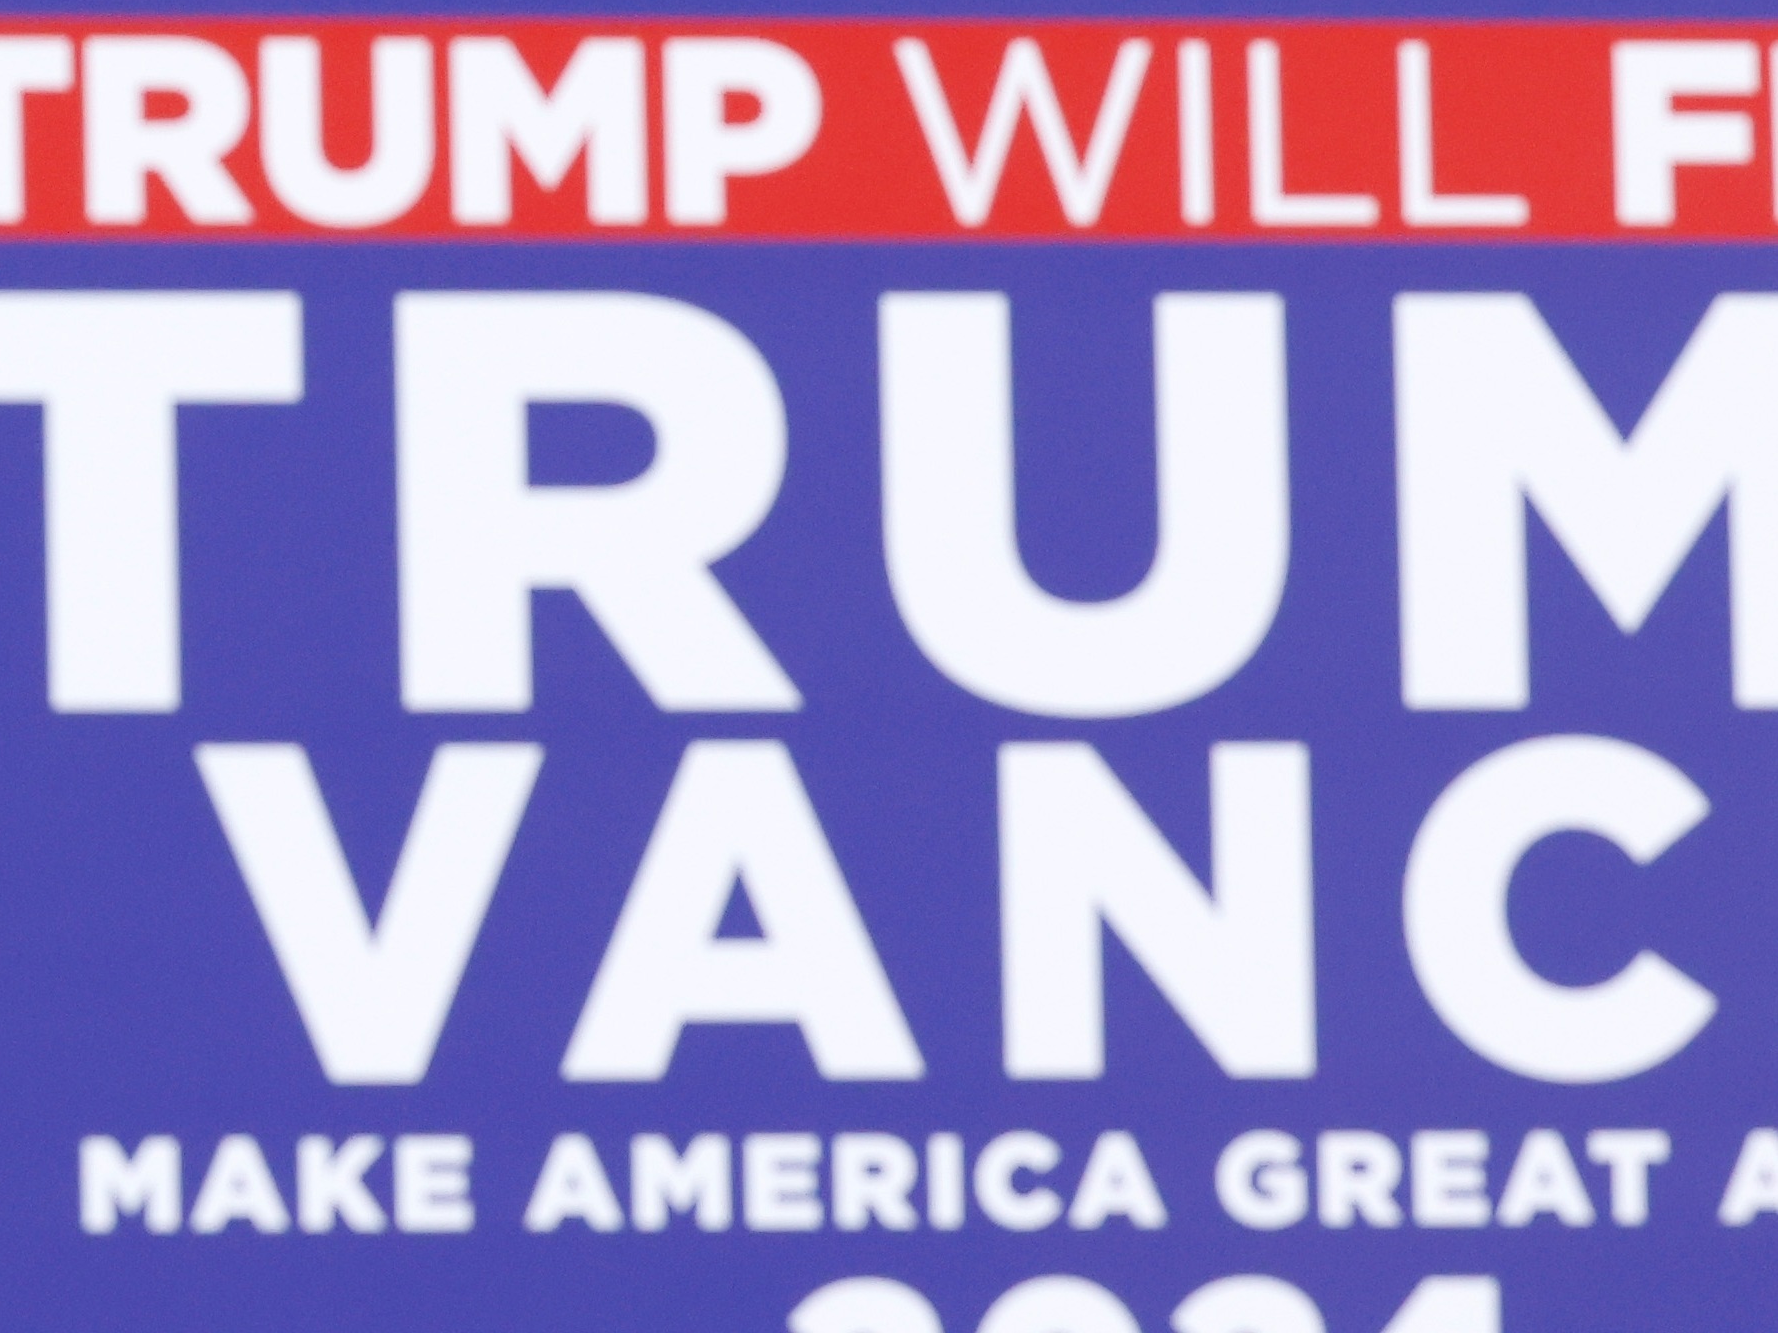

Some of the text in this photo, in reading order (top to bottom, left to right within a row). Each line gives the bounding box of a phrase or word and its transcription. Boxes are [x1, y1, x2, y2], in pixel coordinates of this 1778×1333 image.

[893, 36, 1531, 228] WILL
[1609, 39, 1778, 228] F
[192, 732, 1719, 1087] VANC
[77, 1132, 477, 1236] MAKE
[522, 1129, 1169, 1233] AMERICA
[1213, 1127, 1673, 1231] GREAT
